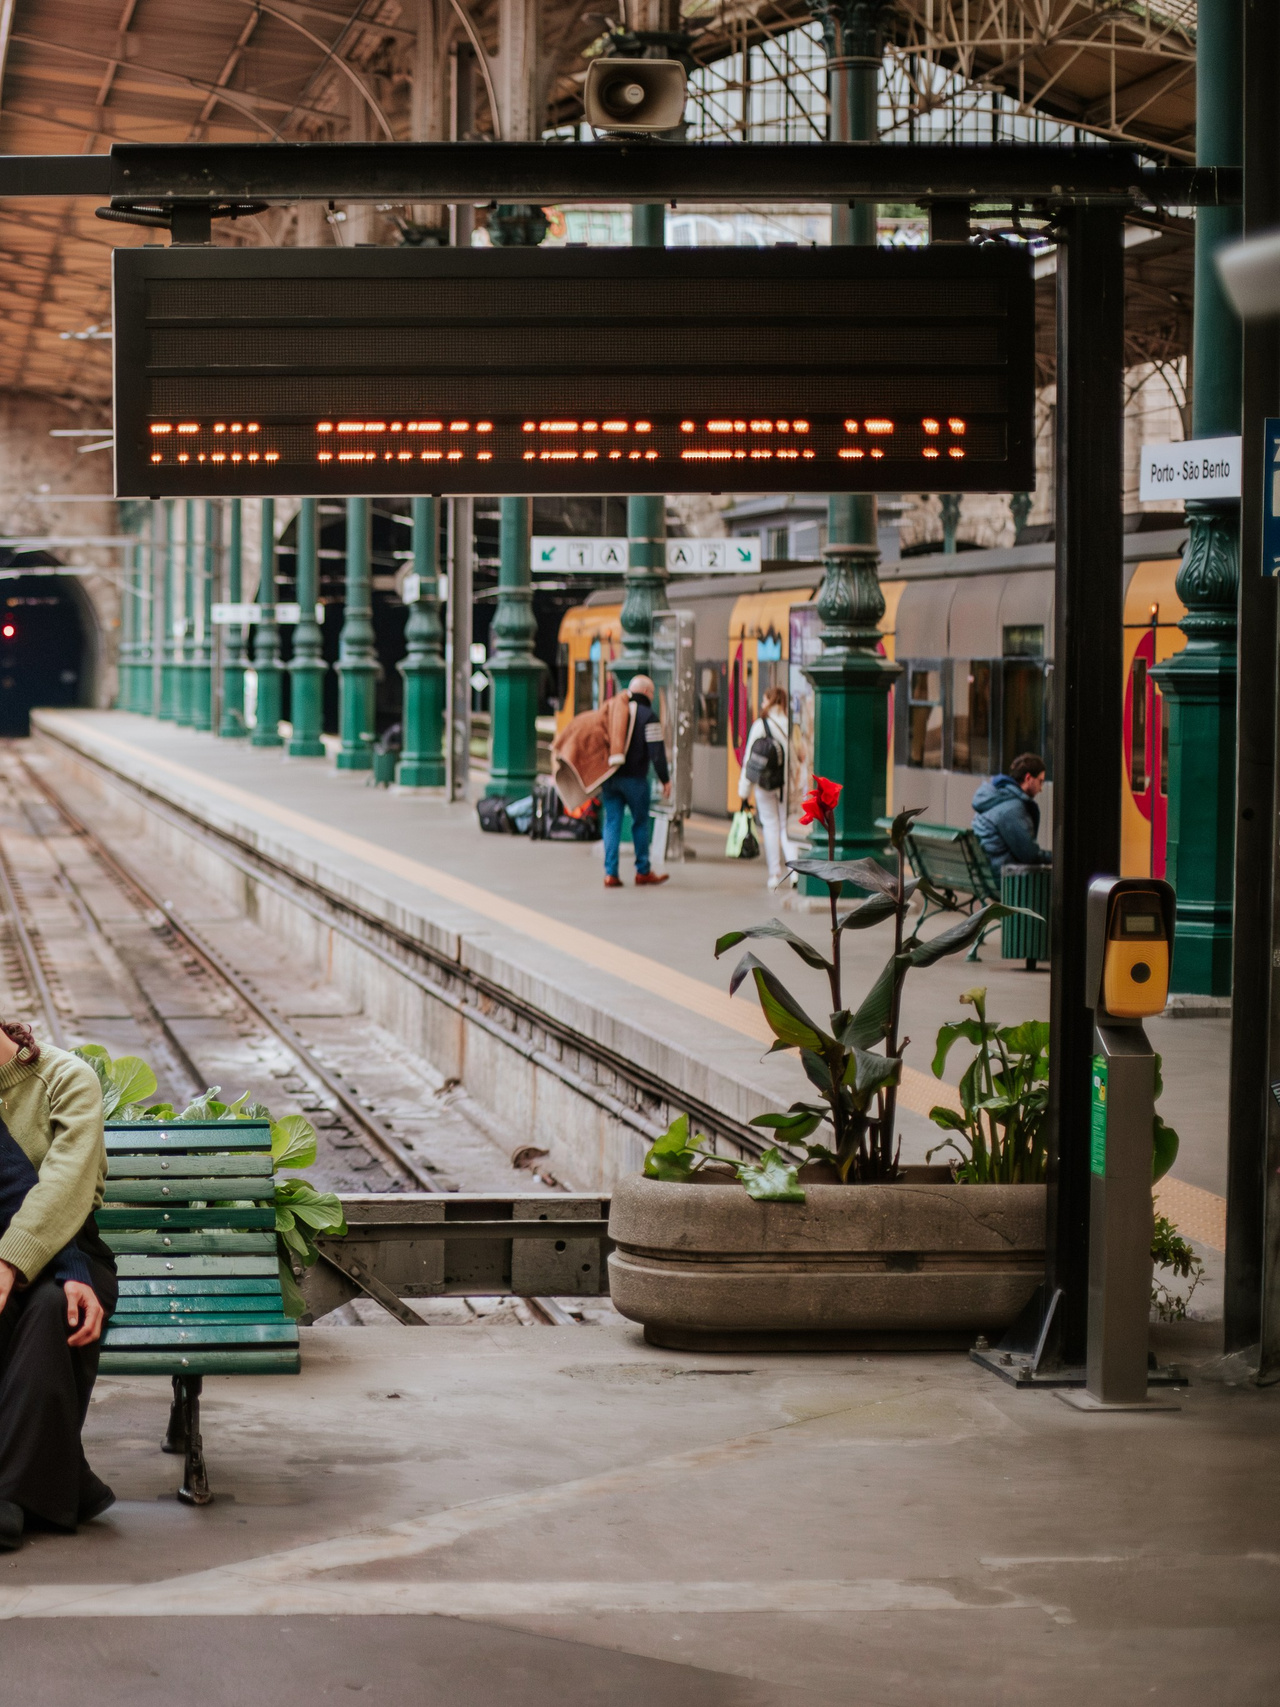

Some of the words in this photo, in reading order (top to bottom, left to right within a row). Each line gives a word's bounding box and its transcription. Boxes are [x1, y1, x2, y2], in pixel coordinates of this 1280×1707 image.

[1151, 463, 1174, 483] Porto
[1182, 460, 1200, 481] São
[1203, 459, 1230, 479] Bento
[577, 551, 585, 567] 1
[606, 548, 619, 564] A
[675, 548, 688, 565] A
[708, 551, 719, 567] 2
